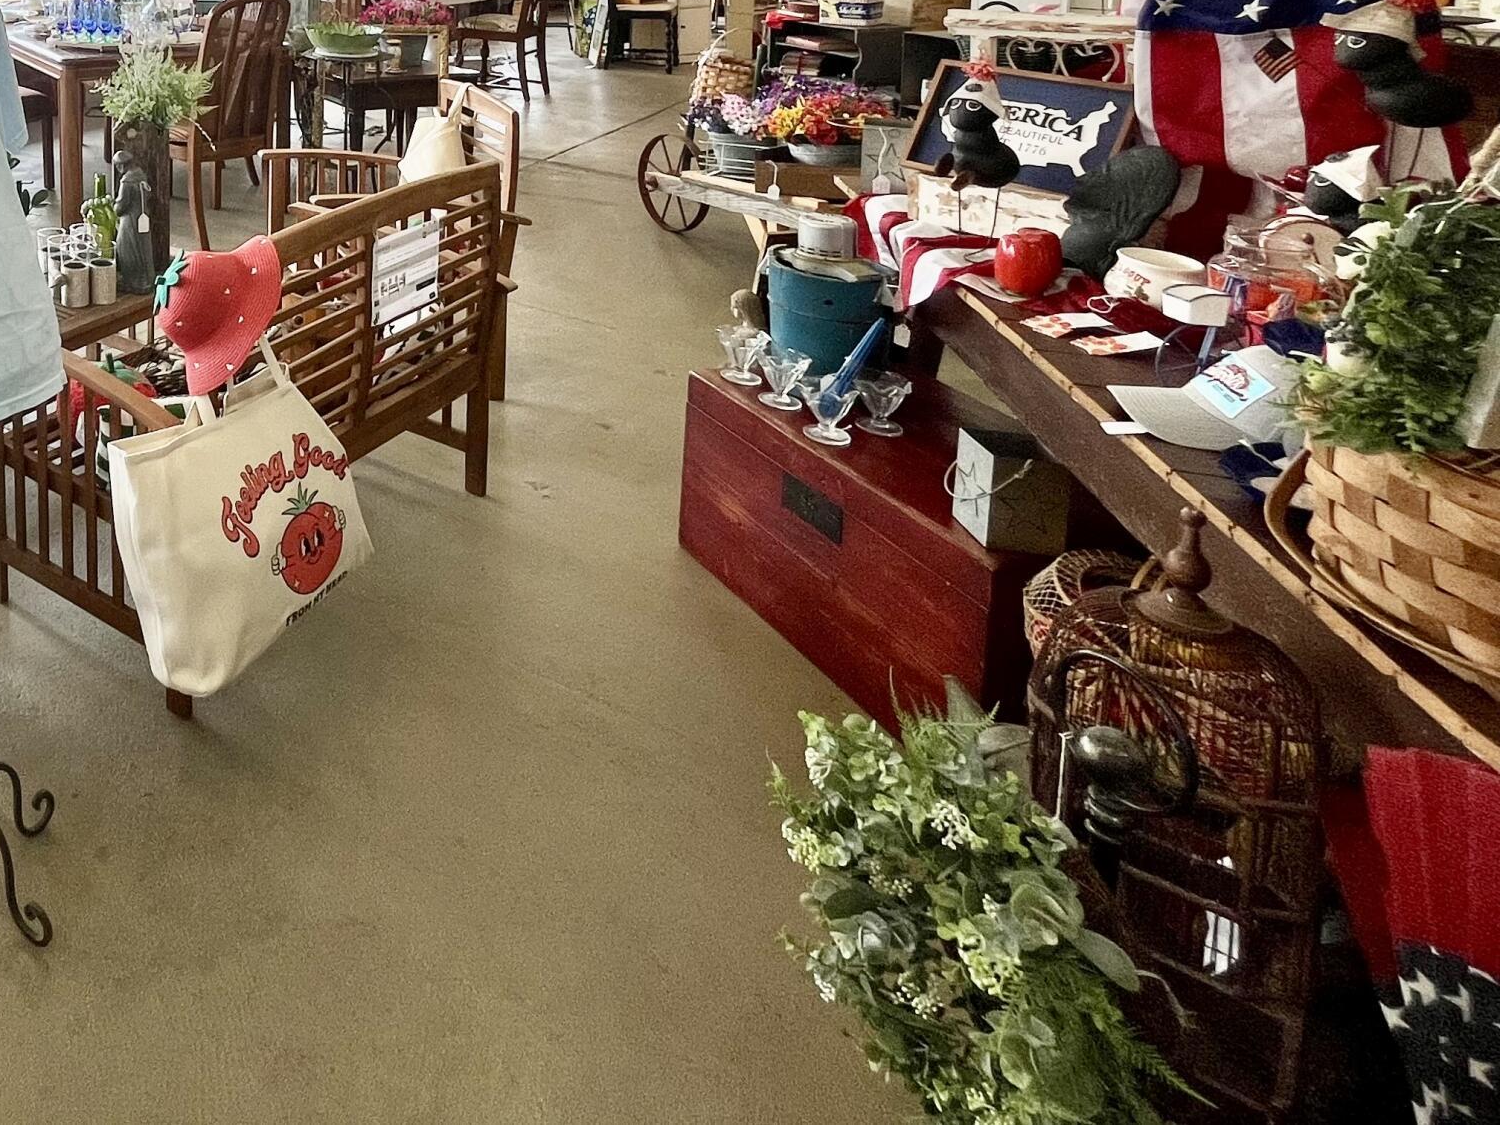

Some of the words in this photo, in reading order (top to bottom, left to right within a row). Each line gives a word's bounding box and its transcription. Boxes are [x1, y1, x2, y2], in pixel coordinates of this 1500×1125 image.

[1002, 105, 1085, 142] ERICA
[1017, 142, 1047, 156] 1776
[221, 450, 295, 558] Feeling
[292, 432, 350, 480] Good
